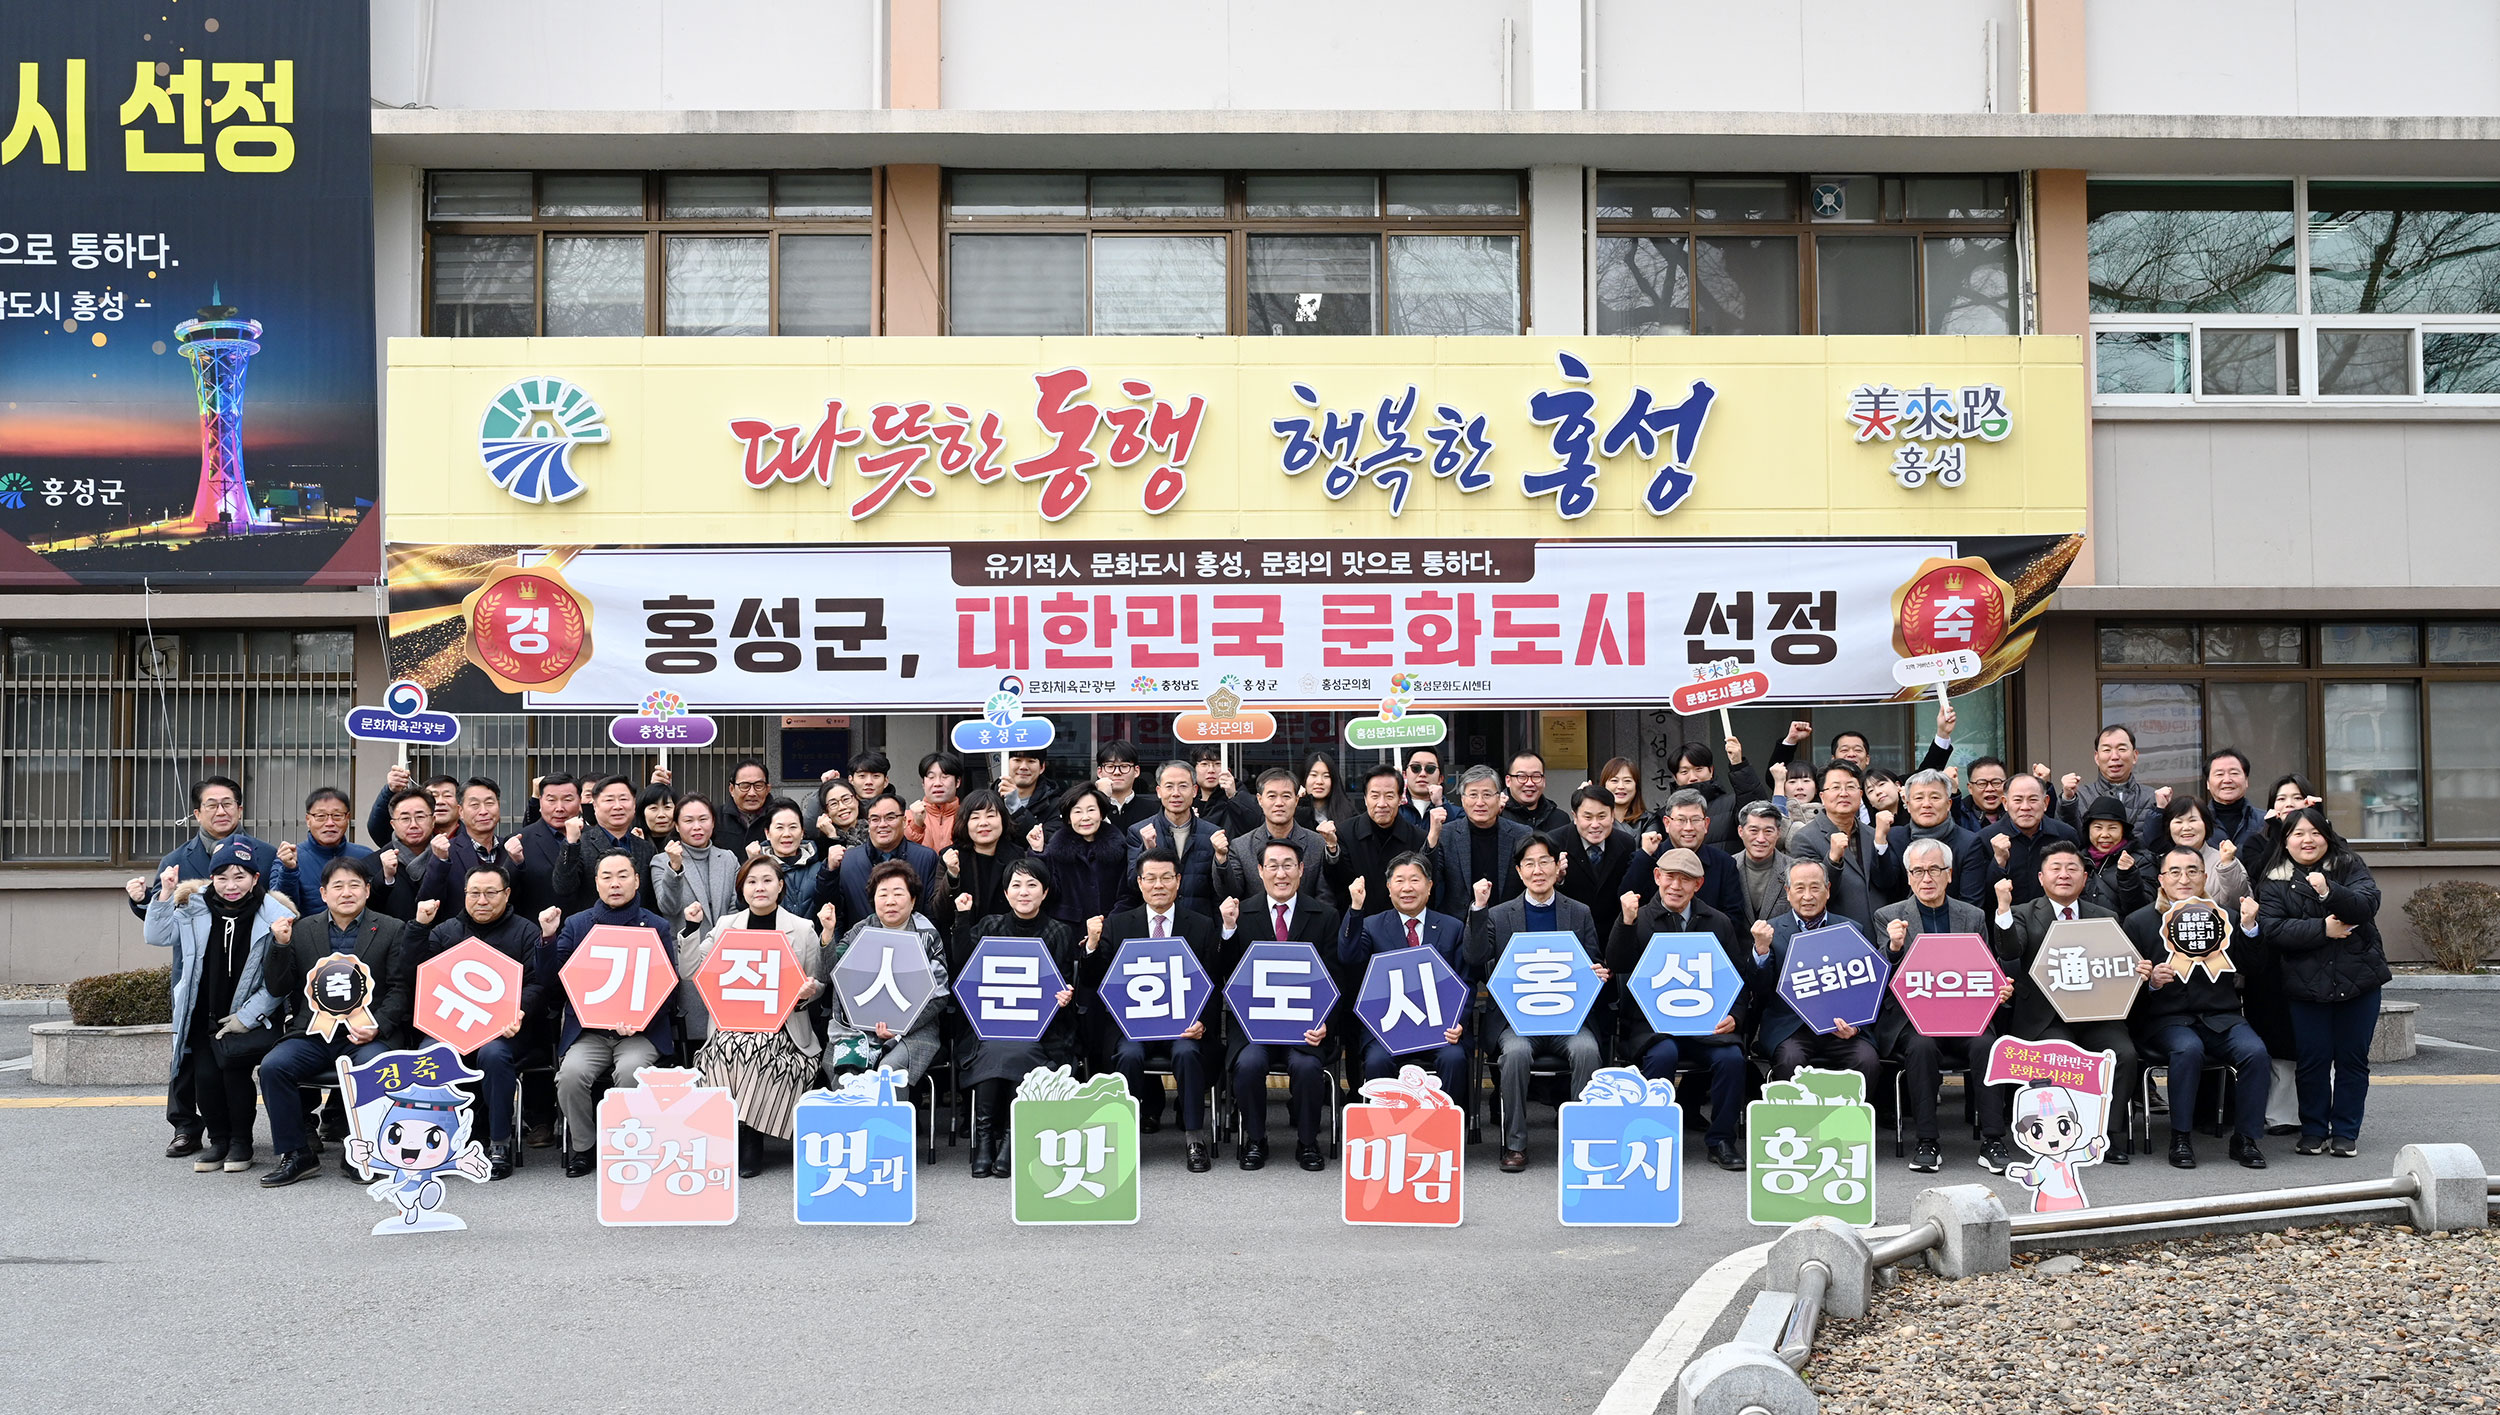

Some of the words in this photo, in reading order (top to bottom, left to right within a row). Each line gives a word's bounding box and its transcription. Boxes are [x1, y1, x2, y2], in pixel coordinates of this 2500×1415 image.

[119, 58, 296, 174] 선정
[68, 232, 180, 270] 통하다.
[0, 290, 61, 322] 도시
[71, 290, 125, 322] 홍성
[1271, 381, 1496, 517] 행복한
[1520, 349, 1719, 520] 홍성
[1849, 384, 2012, 445] 美來路
[729, 398, 1006, 521] 따뜻한
[1012, 366, 1208, 522] 동행
[1893, 444, 1967, 486] 홍성
[39, 477, 126, 507] 홍성군
[1090, 551, 1186, 579] 문화도시
[1195, 550, 1251, 579] 홍성,
[1261, 550, 1332, 578] 문화의
[1341, 550, 1414, 578] 맛으로
[1421, 550, 1501, 577] 통하다.
[504, 606, 552, 656] 경
[641, 593, 921, 680] 홍성군,
[954, 590, 1285, 671] 대한민국
[1321, 589, 1648, 669] 문화도시
[1683, 589, 1838, 666] 선정
[1931, 594, 1977, 643] 축
[1028, 679, 1116, 695] 문화체육관광부
[1161, 679, 1200, 692] 충청남도
[1243, 679, 1278, 692] 홍성군
[1321, 678, 1372, 691] 홍성군의회
[1413, 679, 1492, 692] 홍성문화도시센터
[361, 717, 446, 735] 문화체육관광부
[639, 724, 688, 739] 충청남도
[978, 728, 1029, 745] 홍성군
[1196, 721, 1255, 736] 홍성군의회
[1356, 724, 1437, 740] 홍성문화도시센터
[2178, 921, 2215, 932] 대한민국
[2178, 930, 2215, 942] 문화도시
[2182, 912, 2210, 923] 홍성군
[2188, 940, 2207, 951] 선정
[325, 972, 352, 1002] 축
[431, 959, 507, 1033] 유
[583, 945, 652, 1012] 기
[719, 948, 781, 1015] 적
[977, 955, 1043, 1021] 문
[1122, 955, 1192, 1020] 화
[1248, 959, 1314, 1022] 도
[1379, 961, 1444, 1034] 시
[1512, 948, 1578, 1016] 홍
[1651, 952, 1714, 1018] 성
[1790, 955, 1878, 1001] 문화의
[1905, 970, 1996, 1000] 맛으로
[374, 1063, 402, 1090] 경
[411, 1055, 440, 1081] 축
[2003, 1046, 2042, 1064] 홍성군
[2043, 1053, 2096, 1072] 대한민국
[601, 1117, 732, 1197] 홍성의
[799, 1128, 909, 1198] 멋과
[1033, 1126, 1116, 1200] 맛
[1345, 1132, 1460, 1205] 미감
[1565, 1135, 1682, 1196] 도시
[1754, 1125, 1869, 1206] 홍성
